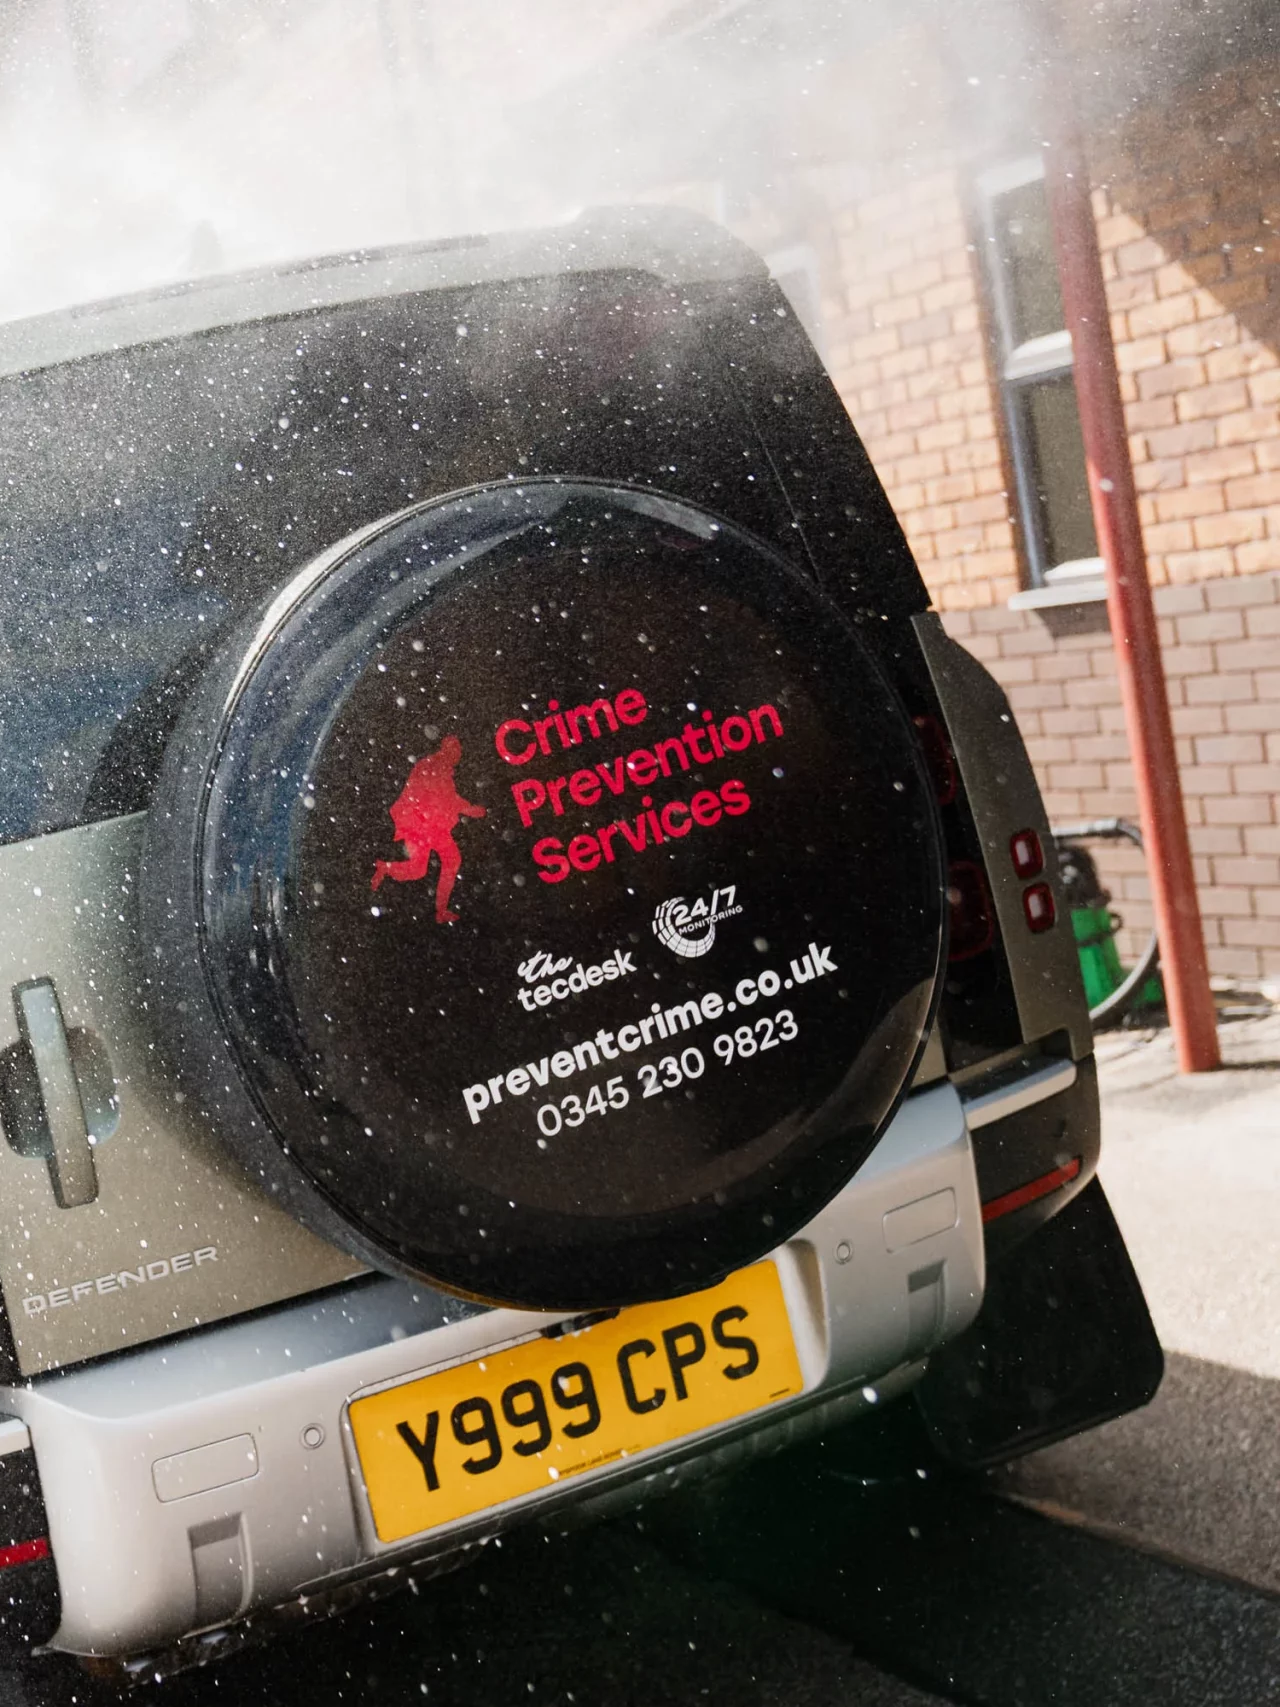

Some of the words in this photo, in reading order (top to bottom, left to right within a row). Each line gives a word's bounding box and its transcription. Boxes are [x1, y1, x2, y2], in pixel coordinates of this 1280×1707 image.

[495, 688, 647, 766] Crime
[512, 704, 785, 827] Prevention
[532, 777, 751, 884] Services
[672, 885, 736, 927] 24/7
[678, 905, 743, 935] MONITORING
[517, 950, 573, 983] the
[517, 949, 638, 1011] tecdesk
[462, 942, 838, 1124] preventcrime.co.uk
[537, 1076, 630, 1136] 0345
[637, 1047, 705, 1098] 230
[713, 1009, 799, 1066] 9823
[22, 1246, 219, 1314] DEFENDER
[396, 1361, 601, 1492] Y999
[616, 1305, 760, 1415] CPS
